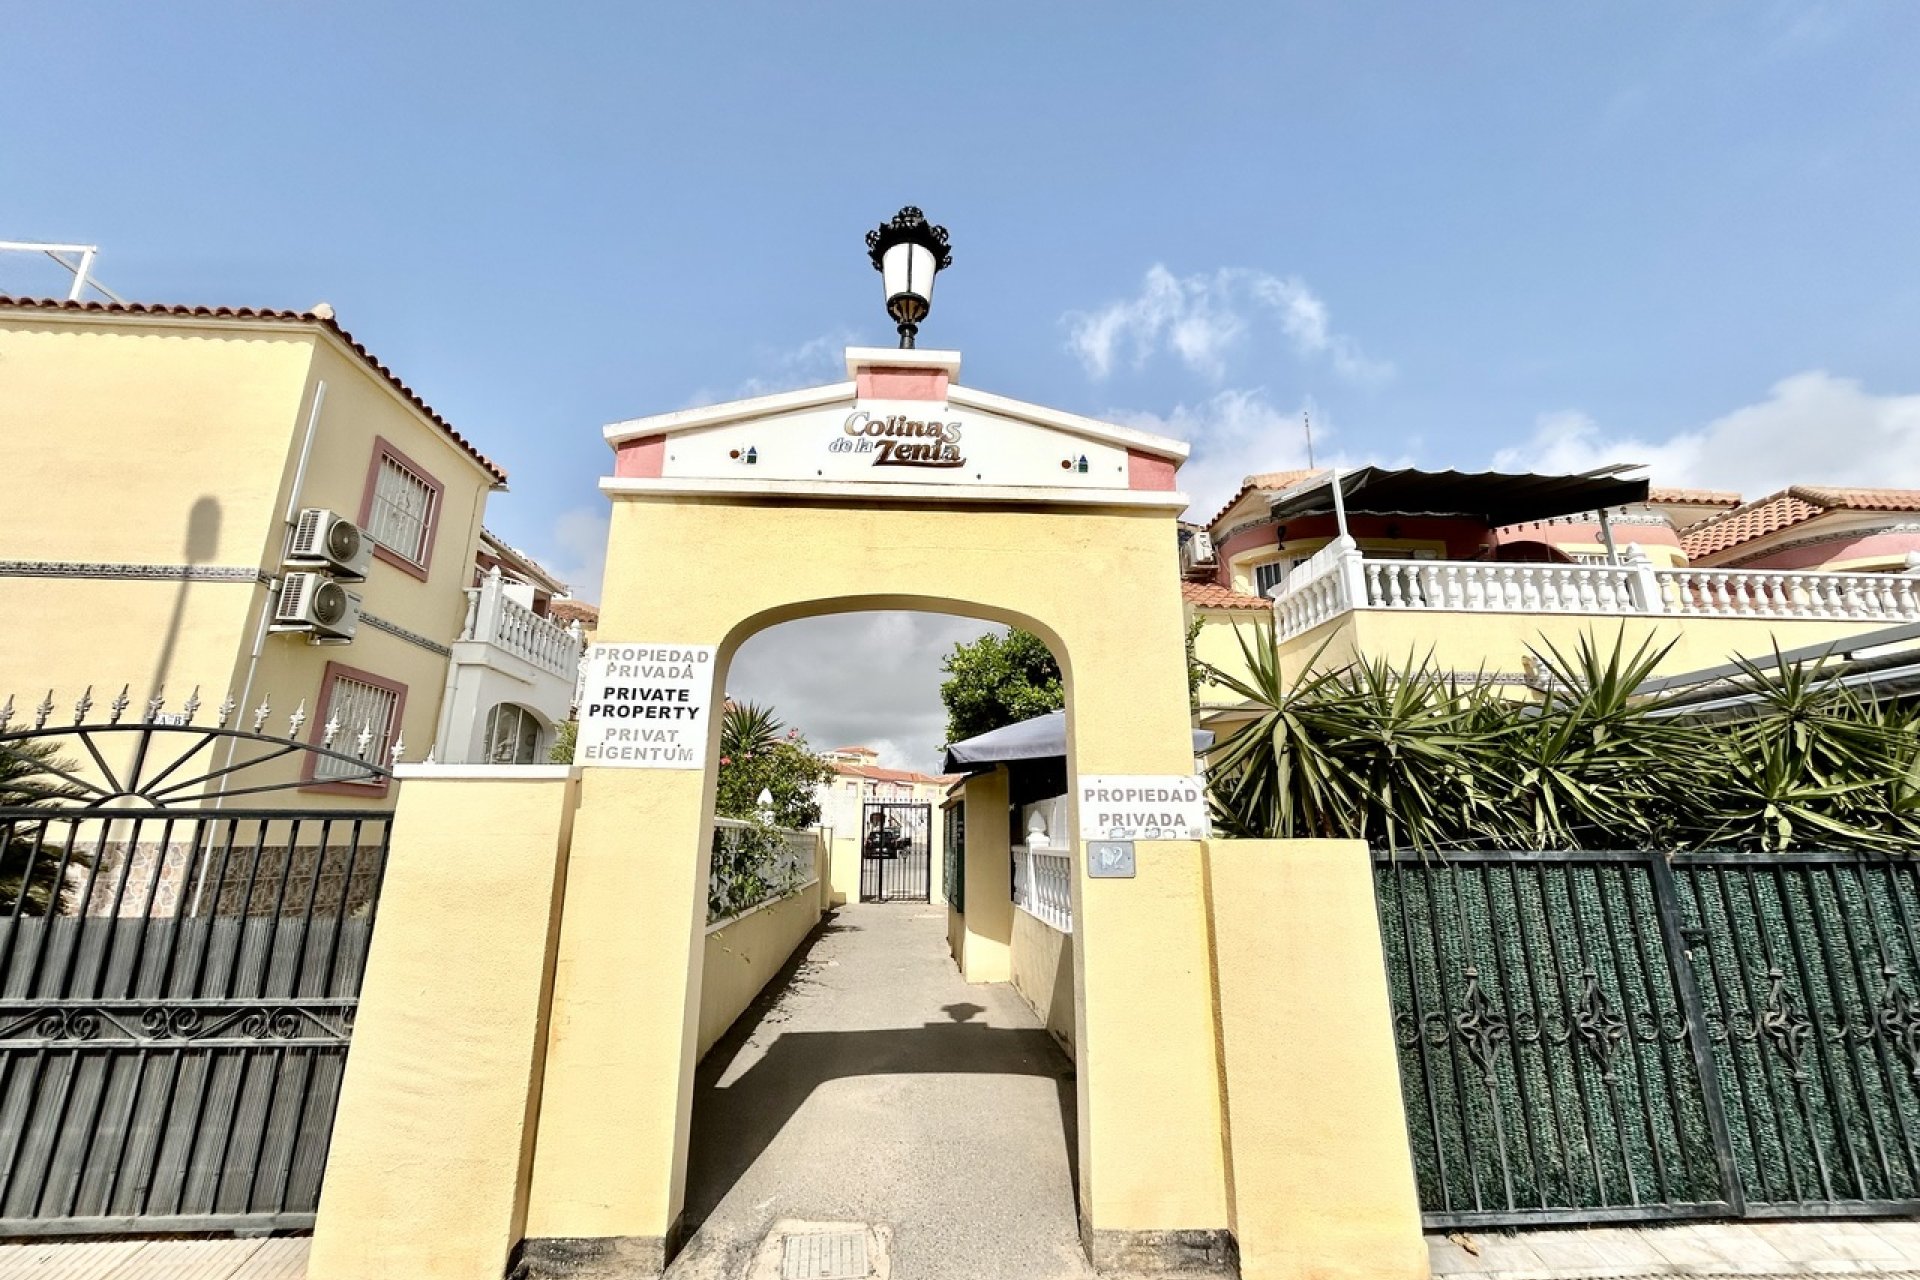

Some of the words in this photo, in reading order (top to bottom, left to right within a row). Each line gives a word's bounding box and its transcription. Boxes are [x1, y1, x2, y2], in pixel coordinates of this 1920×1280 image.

[844, 411, 962, 443] Colinas
[829, 438, 852, 453] de
[855, 438, 873, 453] la
[873, 440, 966, 467] Zenia
[594, 648, 709, 663] PROPIEDAD
[605, 665, 694, 679] PRIVADA
[603, 687, 689, 702] PRIVATE
[589, 704, 699, 719] PROPERTY
[605, 728, 679, 742] PRIVAT
[585, 745, 693, 760] EIGENTUM
[1085, 789, 1197, 802] PROPIEDAD
[1099, 813, 1186, 826] PRIVADA
